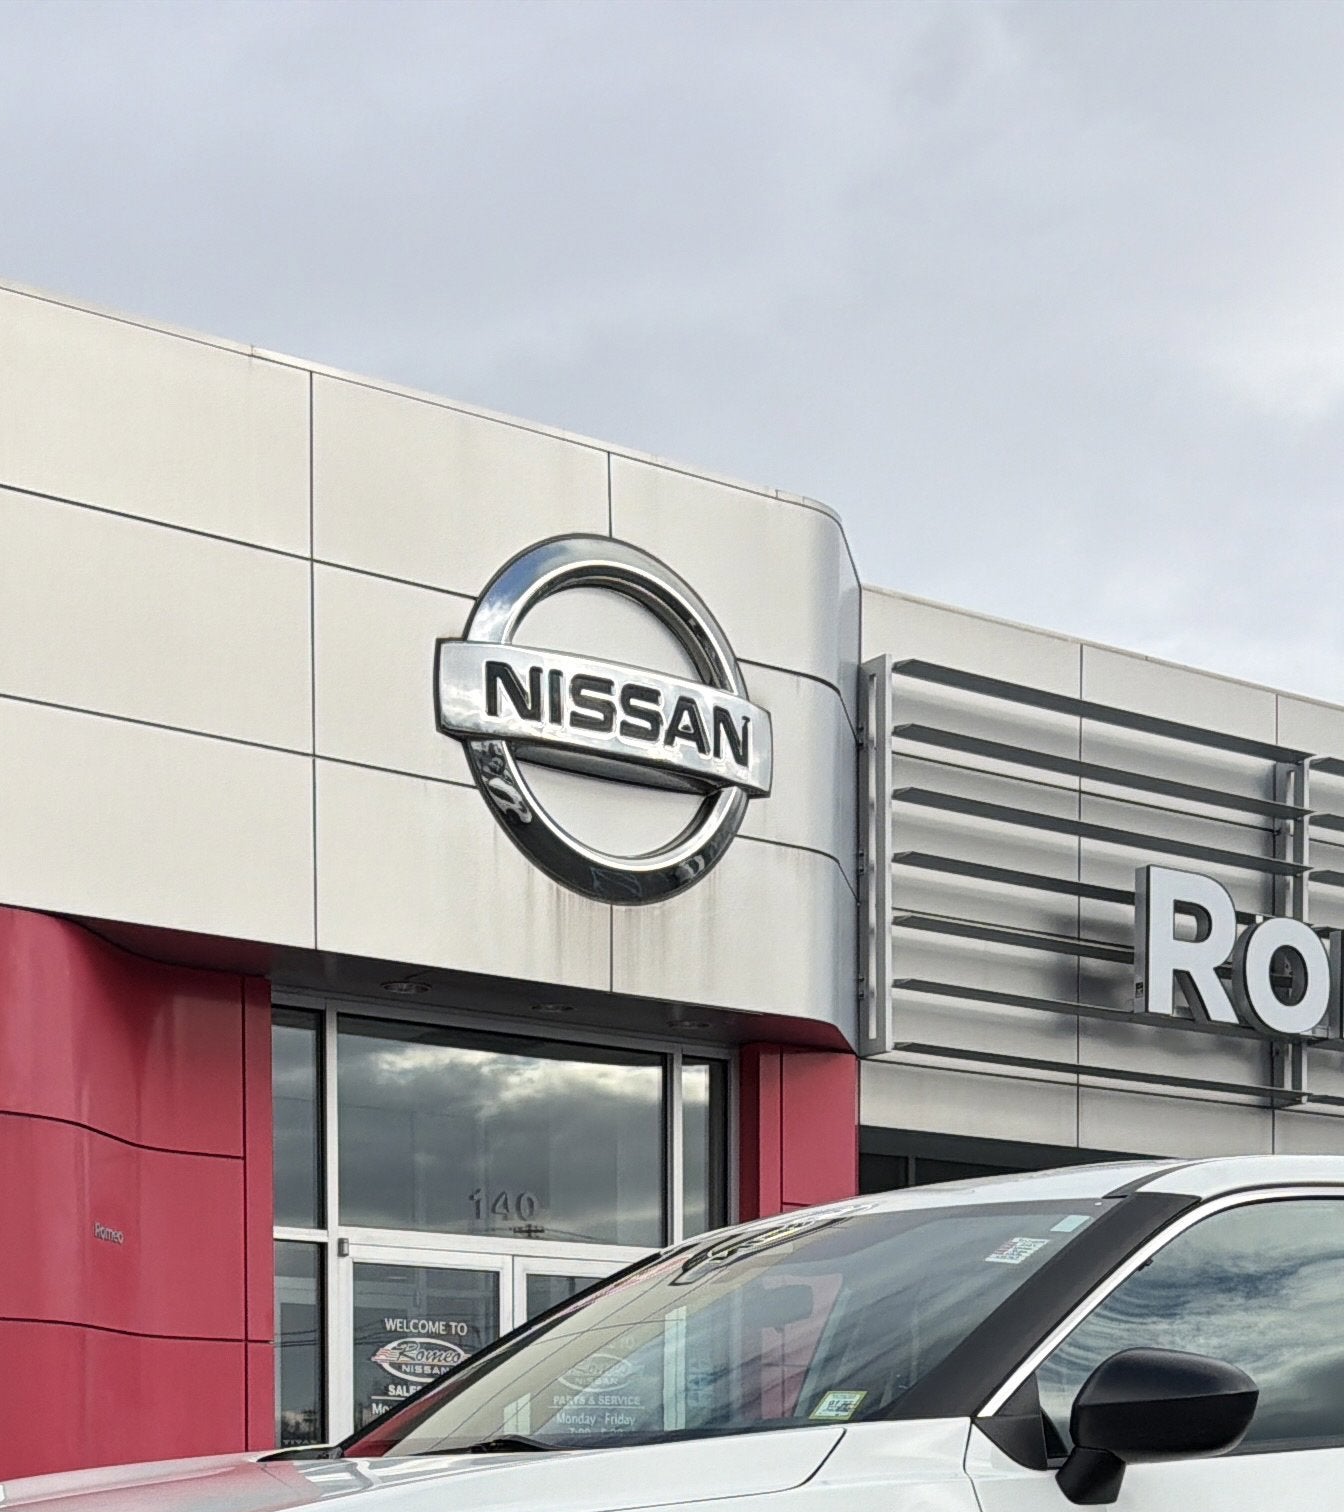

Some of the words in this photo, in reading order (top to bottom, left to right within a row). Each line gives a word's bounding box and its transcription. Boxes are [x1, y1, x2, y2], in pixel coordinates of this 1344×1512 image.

[485, 660, 751, 768] NISSAN
[468, 1188, 537, 1221] 140
[94, 1221, 124, 1244] Romeo
[384, 1318, 447, 1335] WELCOME
[449, 1321, 468, 1336] TO
[394, 1341, 462, 1364] Romeo
[401, 1364, 452, 1375] NISSAN
[553, 1395, 586, 1406] PARTS
[587, 1396, 596, 1406] &
[598, 1395, 641, 1406] SERVICE
[556, 1412, 597, 1426] Monday
[604, 1412, 636, 1426] Friday
